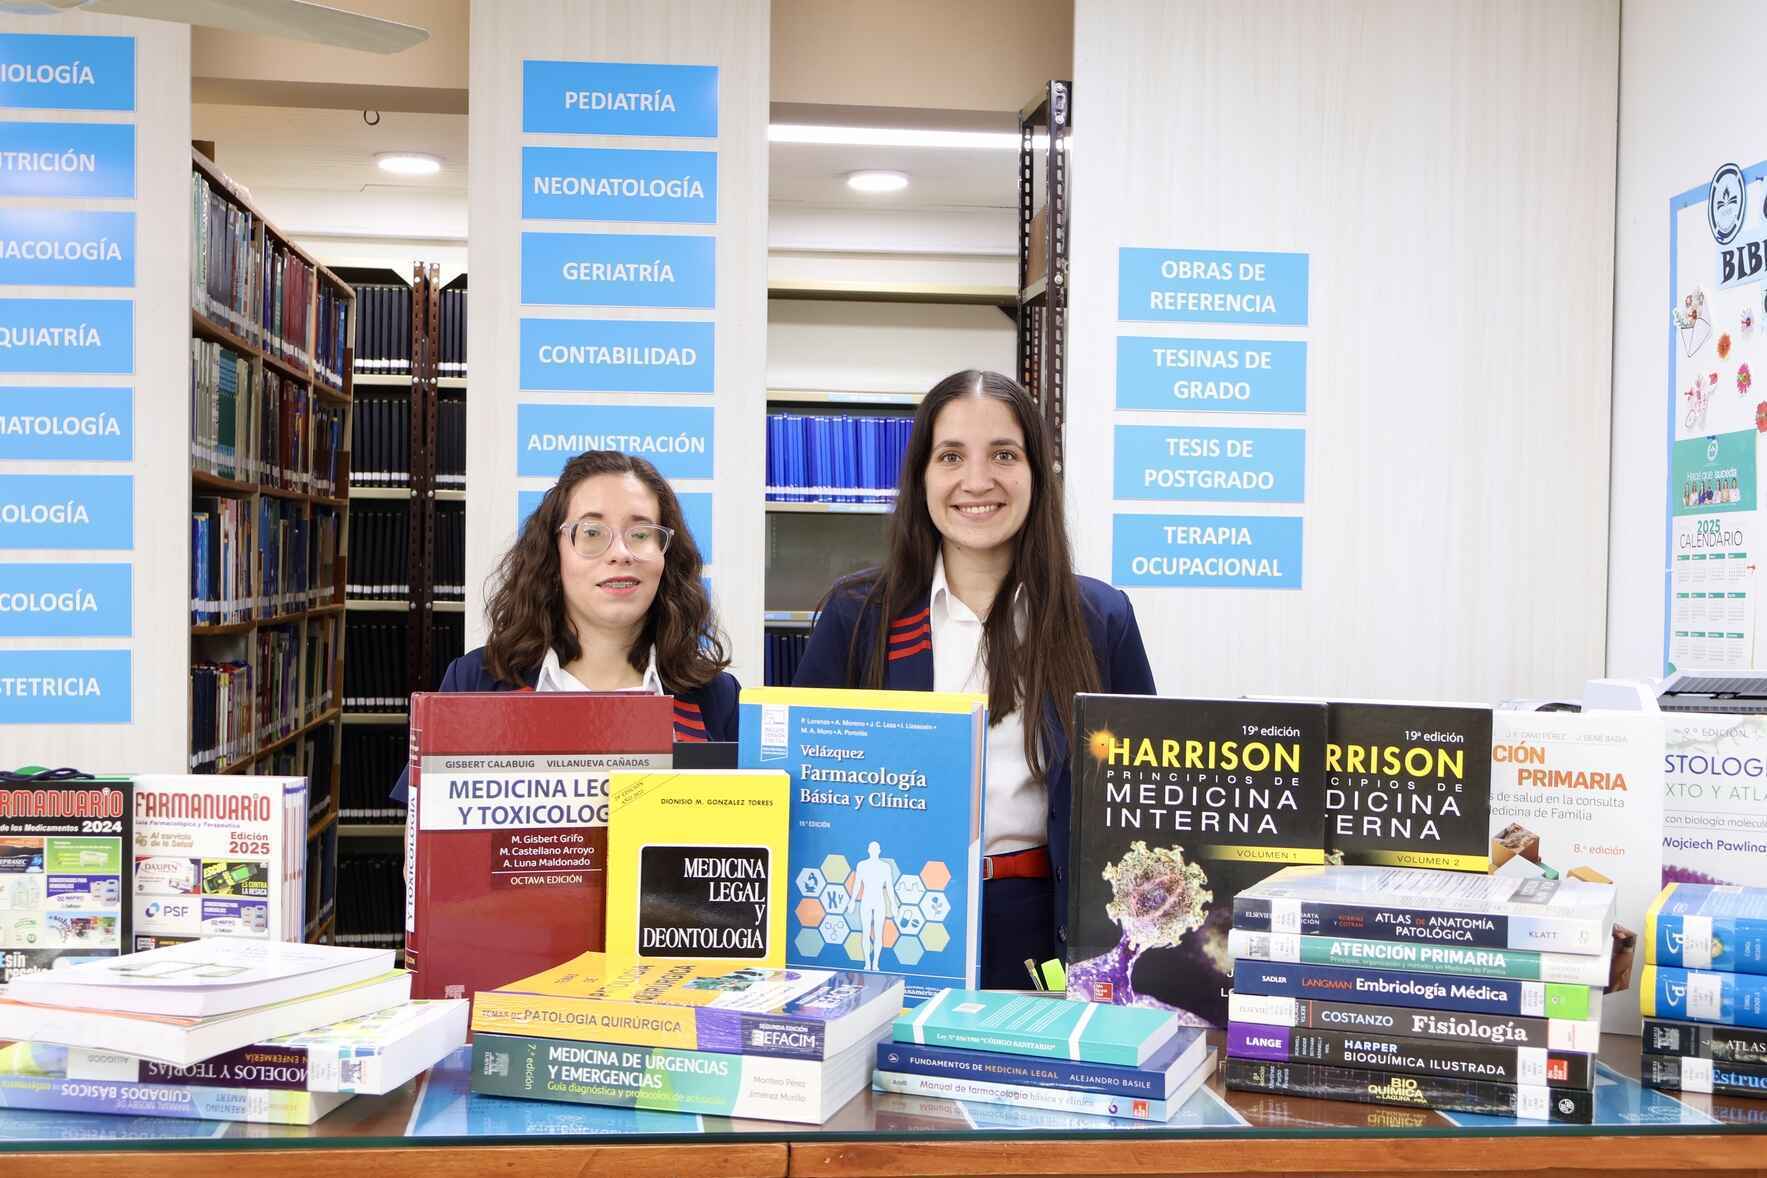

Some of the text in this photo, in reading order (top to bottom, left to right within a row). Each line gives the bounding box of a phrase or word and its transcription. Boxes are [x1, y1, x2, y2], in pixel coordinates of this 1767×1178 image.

[1, 61, 95, 84] IOLOGÍA
[565, 90, 676, 112] PEDIATRÍA
[534, 176, 705, 199] NEONATOLOGÍA
[563, 260, 675, 283] GERIATRÍA
[1161, 260, 1266, 281] OBRAS DE
[1721, 239, 1767, 284] BIB
[1150, 291, 1277, 313] REFERENCIA
[538, 345, 697, 366] CONTABILIDAD
[1153, 349, 1272, 369] TESINAS DE
[1173, 380, 1250, 400] GRADO
[527, 432, 705, 453] ADMINISTRACIÓN
[1166, 437, 1254, 458] TESIS DE
[1144, 469, 1275, 490] POSTGRADO
[1164, 526, 1252, 545] TERAPIA
[1697, 520, 1720, 534] 2025
[1680, 530, 1743, 548] CALENDARIO
[1131, 556, 1283, 577] OCUPACIONAL
[0, 589, 97, 612] COLOGÍA
[1261, 726, 1300, 737] edición
[1423, 732, 1464, 743] edición
[801, 744, 864, 760] Velázquez
[1107, 738, 1300, 773] HARRISON
[1326, 744, 1464, 779] RRISON
[1493, 741, 1546, 765] CIÓN
[445, 757, 650, 769] GISBERT CALABUIG VILLANUEVA CAÑADAS
[801, 764, 928, 790] Farmacología
[1106, 771, 1299, 786] PRINCIPIOS DE
[1518, 769, 1629, 792] PRIMARIA
[449, 780, 567, 800] MEDICINA
[1106, 783, 1298, 810] MEDICINA
[1437, 783, 1463, 793] DE
[1711, 785, 1721, 800] Y
[800, 789, 927, 810] Básica y Clínica
[1326, 790, 1461, 817] DICINA
[1497, 791, 1625, 809] de salud en la consulta
[459, 804, 609, 826] Y TOXICOLOG
[1106, 807, 1278, 835] INTERNA
[1534, 807, 1546, 818] de
[1551, 809, 1593, 822] Familia
[1665, 815, 1682, 824] con
[11, 820, 122, 833] los Medicamentos 2024
[230, 832, 268, 841] Edición
[229, 842, 270, 854] 2025
[511, 834, 584, 844] M. Gisbert Grifo
[499, 846, 595, 858] M. Castellano Arroyo
[1236, 850, 1289, 859] VOLUMEN
[1589, 845, 1625, 855] edición
[503, 857, 591, 868] A. Luna Maldonado
[684, 857, 766, 879] MEDICINA
[1397, 855, 1460, 867] VOLUMEN 2
[511, 874, 583, 885] OCTAVA EDICIÓN
[709, 881, 766, 902] LEGAL
[163, 906, 189, 918] PSF
[755, 904, 766, 925] y
[1375, 911, 1411, 925] ATLAS
[1428, 916, 1495, 931] ANATOMÍA
[1395, 926, 1473, 941] PATOLÓGICA
[1529, 931, 1558, 939] KLATT
[1330, 941, 1416, 962] ATENCIÓN
[1421, 946, 1507, 968] PRIMARIA
[1262, 975, 1508, 1002] SADLER LANGMAN Embriología Médica
[524, 1009, 597, 1026] PATOLOGÍA
[601, 1014, 682, 1032] QUIRÚRGICA
[1321, 1011, 1394, 1027] COSTANZO
[1411, 1015, 1529, 1043] Fisiología
[1246, 1036, 1283, 1049] LANGE
[1344, 1040, 1398, 1054] HARPER
[1727, 1039, 1766, 1052] ATLAS
[245, 1054, 299, 1063] ENFERMERÍA
[549, 1046, 728, 1076] MEDICINA DE URGENCIAS
[1343, 1051, 1506, 1075] BIOQUÍMICA ILUSTRADA
[220, 1064, 231, 1079] Y
[524, 1057, 535, 1090] edición
[547, 1065, 663, 1089] Y EMERGENCIAS
[909, 1057, 1151, 1089] FUNDAMENTOS DE MEDICINA LEGAL ALEJANDRO BASILE
[61, 1083, 117, 1100] BÁSICOS
[547, 1080, 624, 1098] Guía diagnóstica y
[920, 1080, 953, 1091] Manual
[955, 1082, 966, 1093] de
[1368, 1084, 1424, 1099] QUÍMICA
[1391, 1077, 1417, 1089] BIO
[121, 1087, 192, 1102] CUIDADOS
